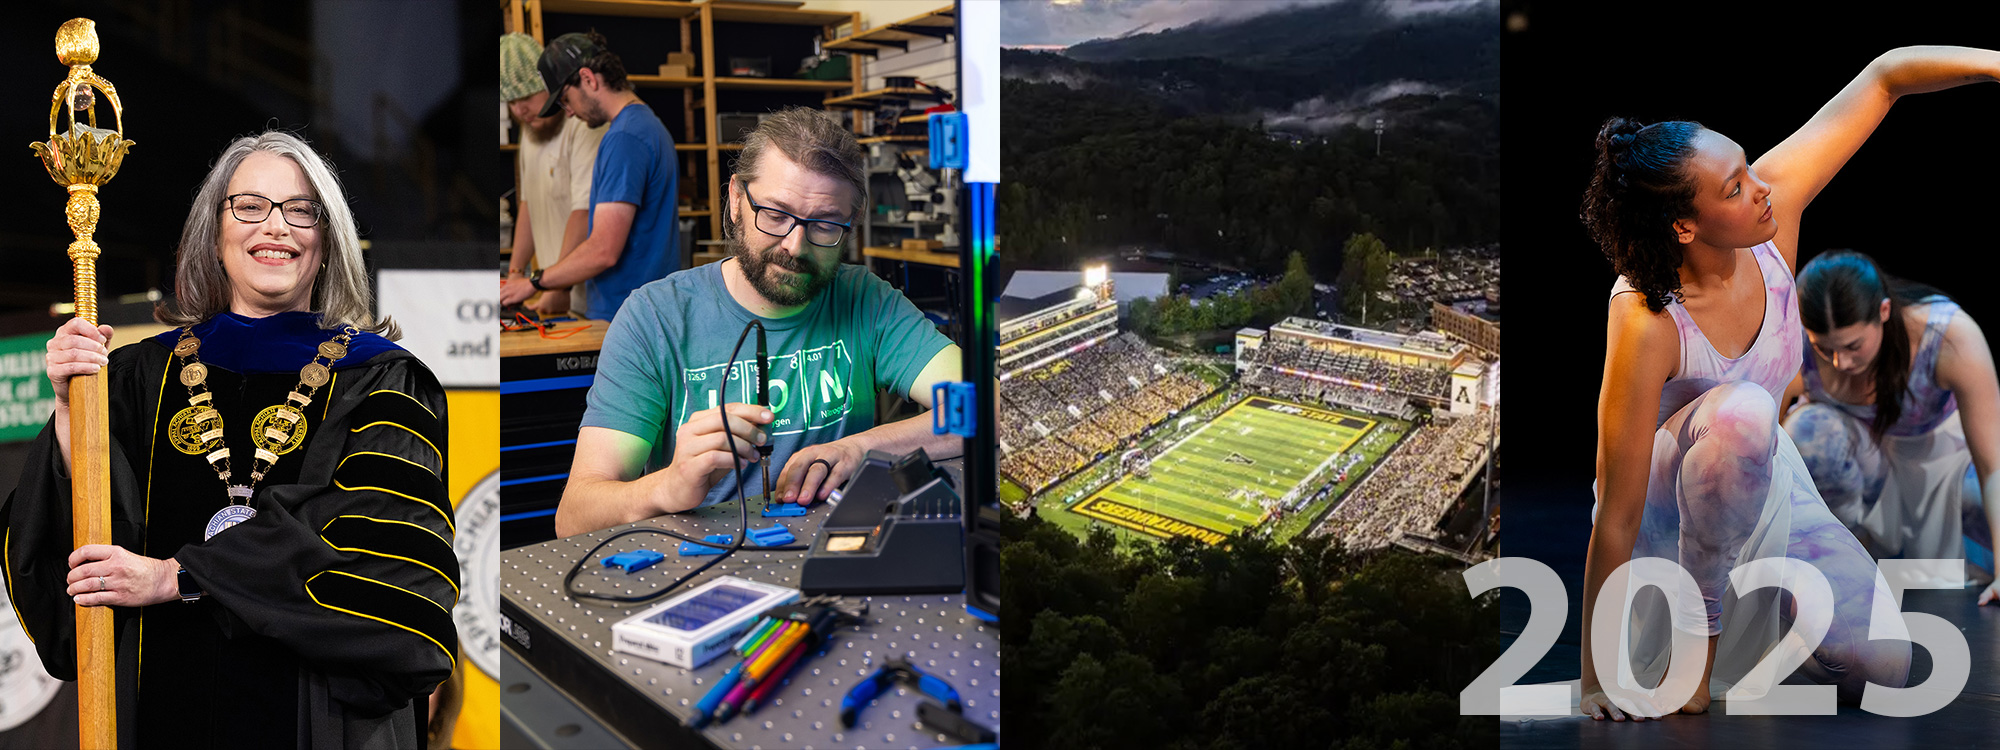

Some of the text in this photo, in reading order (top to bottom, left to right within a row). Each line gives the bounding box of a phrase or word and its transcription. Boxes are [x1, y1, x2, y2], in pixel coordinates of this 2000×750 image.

[447, 335, 490, 357] and
[790, 356, 799, 370] 8
[819, 366, 845, 404] N
[1455, 385, 1471, 404] A
[772, 417, 791, 429] ygen
